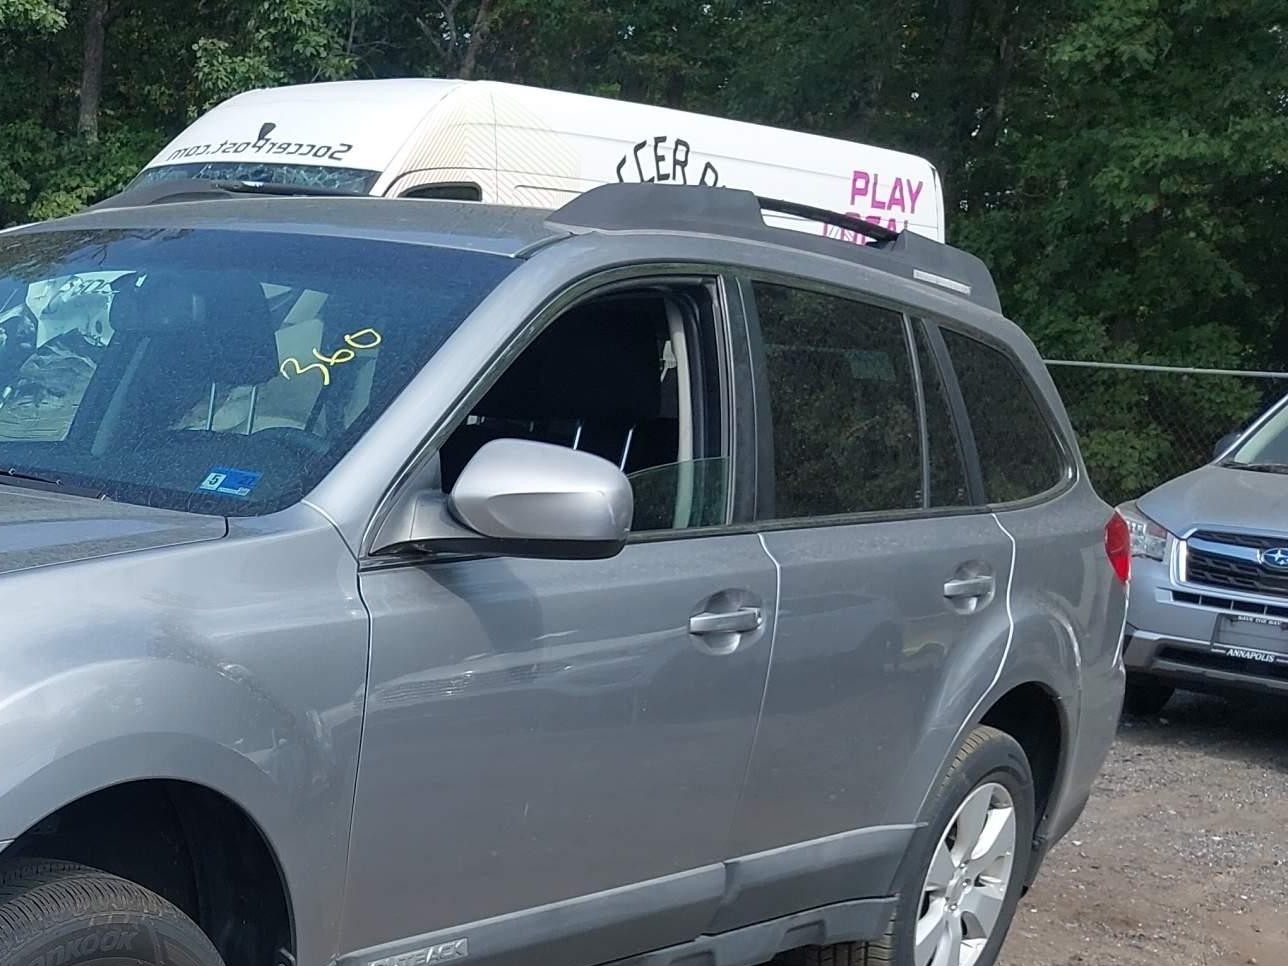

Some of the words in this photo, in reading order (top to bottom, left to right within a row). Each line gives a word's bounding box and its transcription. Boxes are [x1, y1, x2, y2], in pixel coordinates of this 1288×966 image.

[850, 170, 923, 214] PLAY
[280, 328, 381, 386] 360
[1226, 649, 1275, 663] ANNAPOLIS
